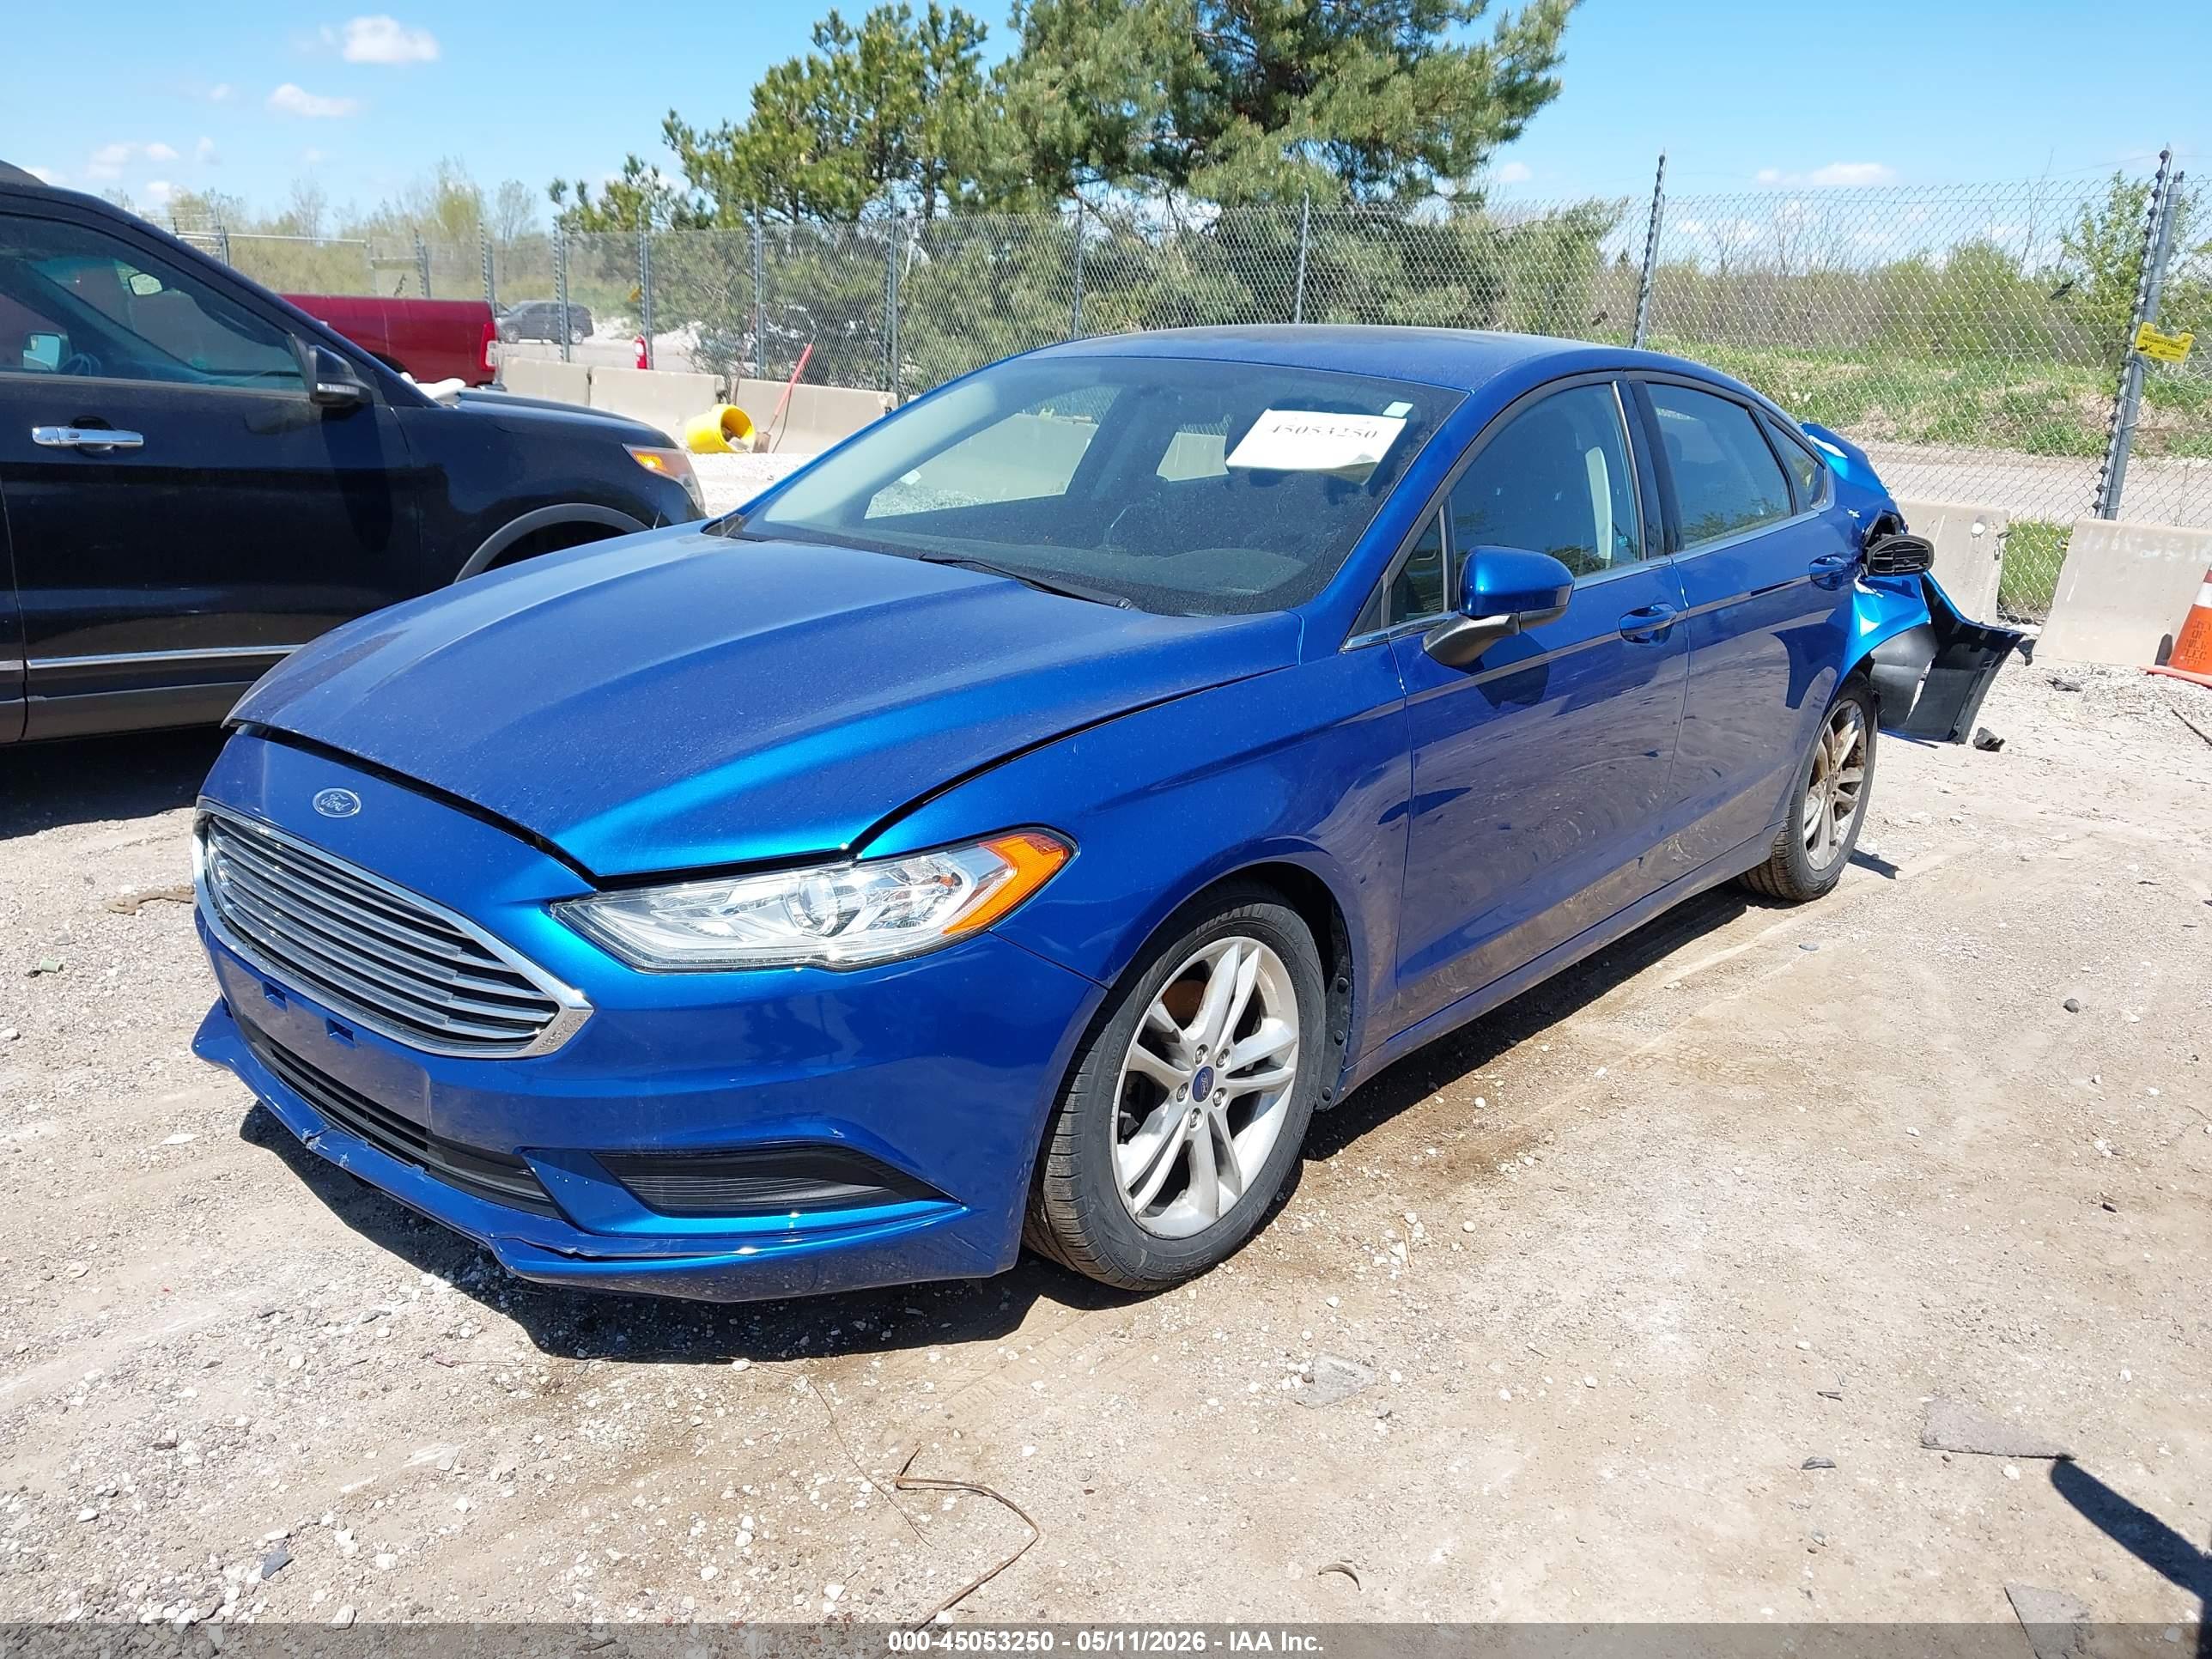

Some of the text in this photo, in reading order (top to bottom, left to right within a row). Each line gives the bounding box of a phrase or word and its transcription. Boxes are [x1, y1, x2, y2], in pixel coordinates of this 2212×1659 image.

[2142, 335, 2185, 351] SECURITY FENCE
[320, 793, 351, 811] Ford
